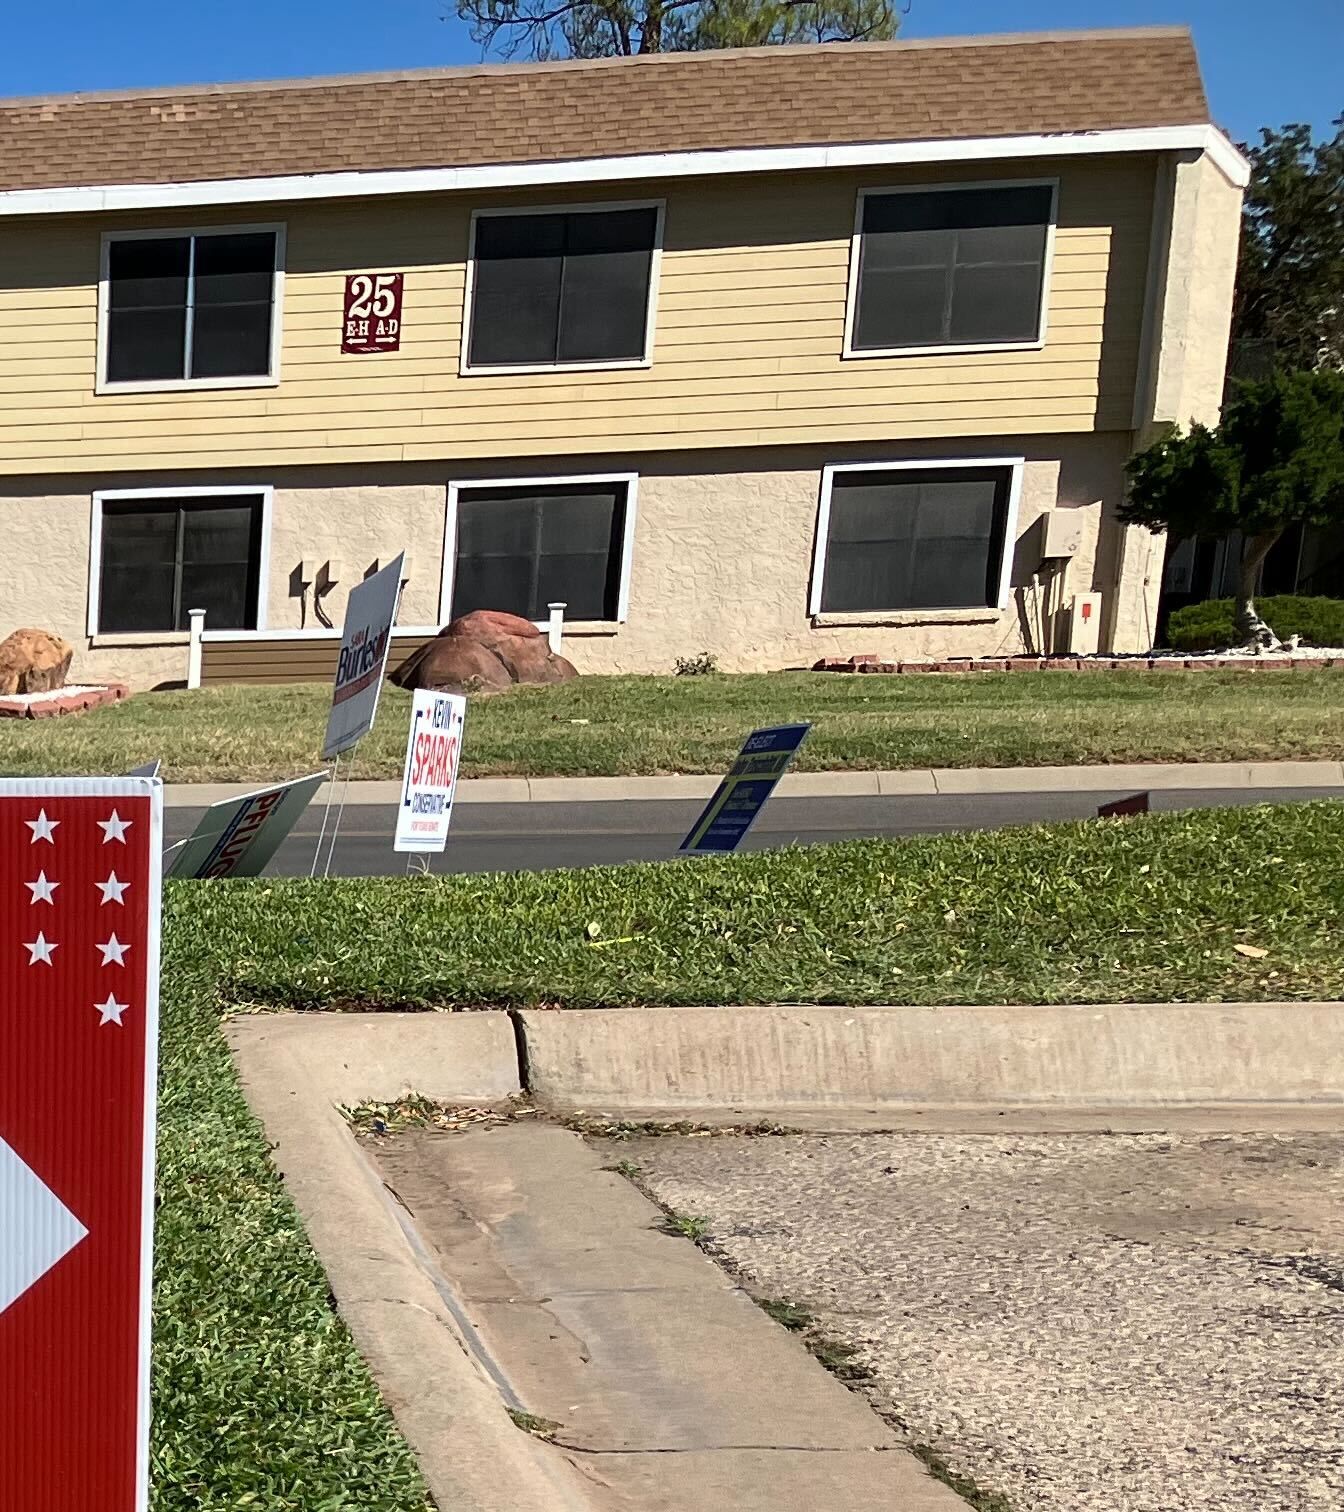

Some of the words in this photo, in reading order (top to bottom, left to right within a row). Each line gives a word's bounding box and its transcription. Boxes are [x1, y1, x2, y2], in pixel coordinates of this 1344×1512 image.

[348, 275, 396, 318] 25
[432, 699, 453, 730] KEVIN
[412, 732, 456, 787] SPARKS
